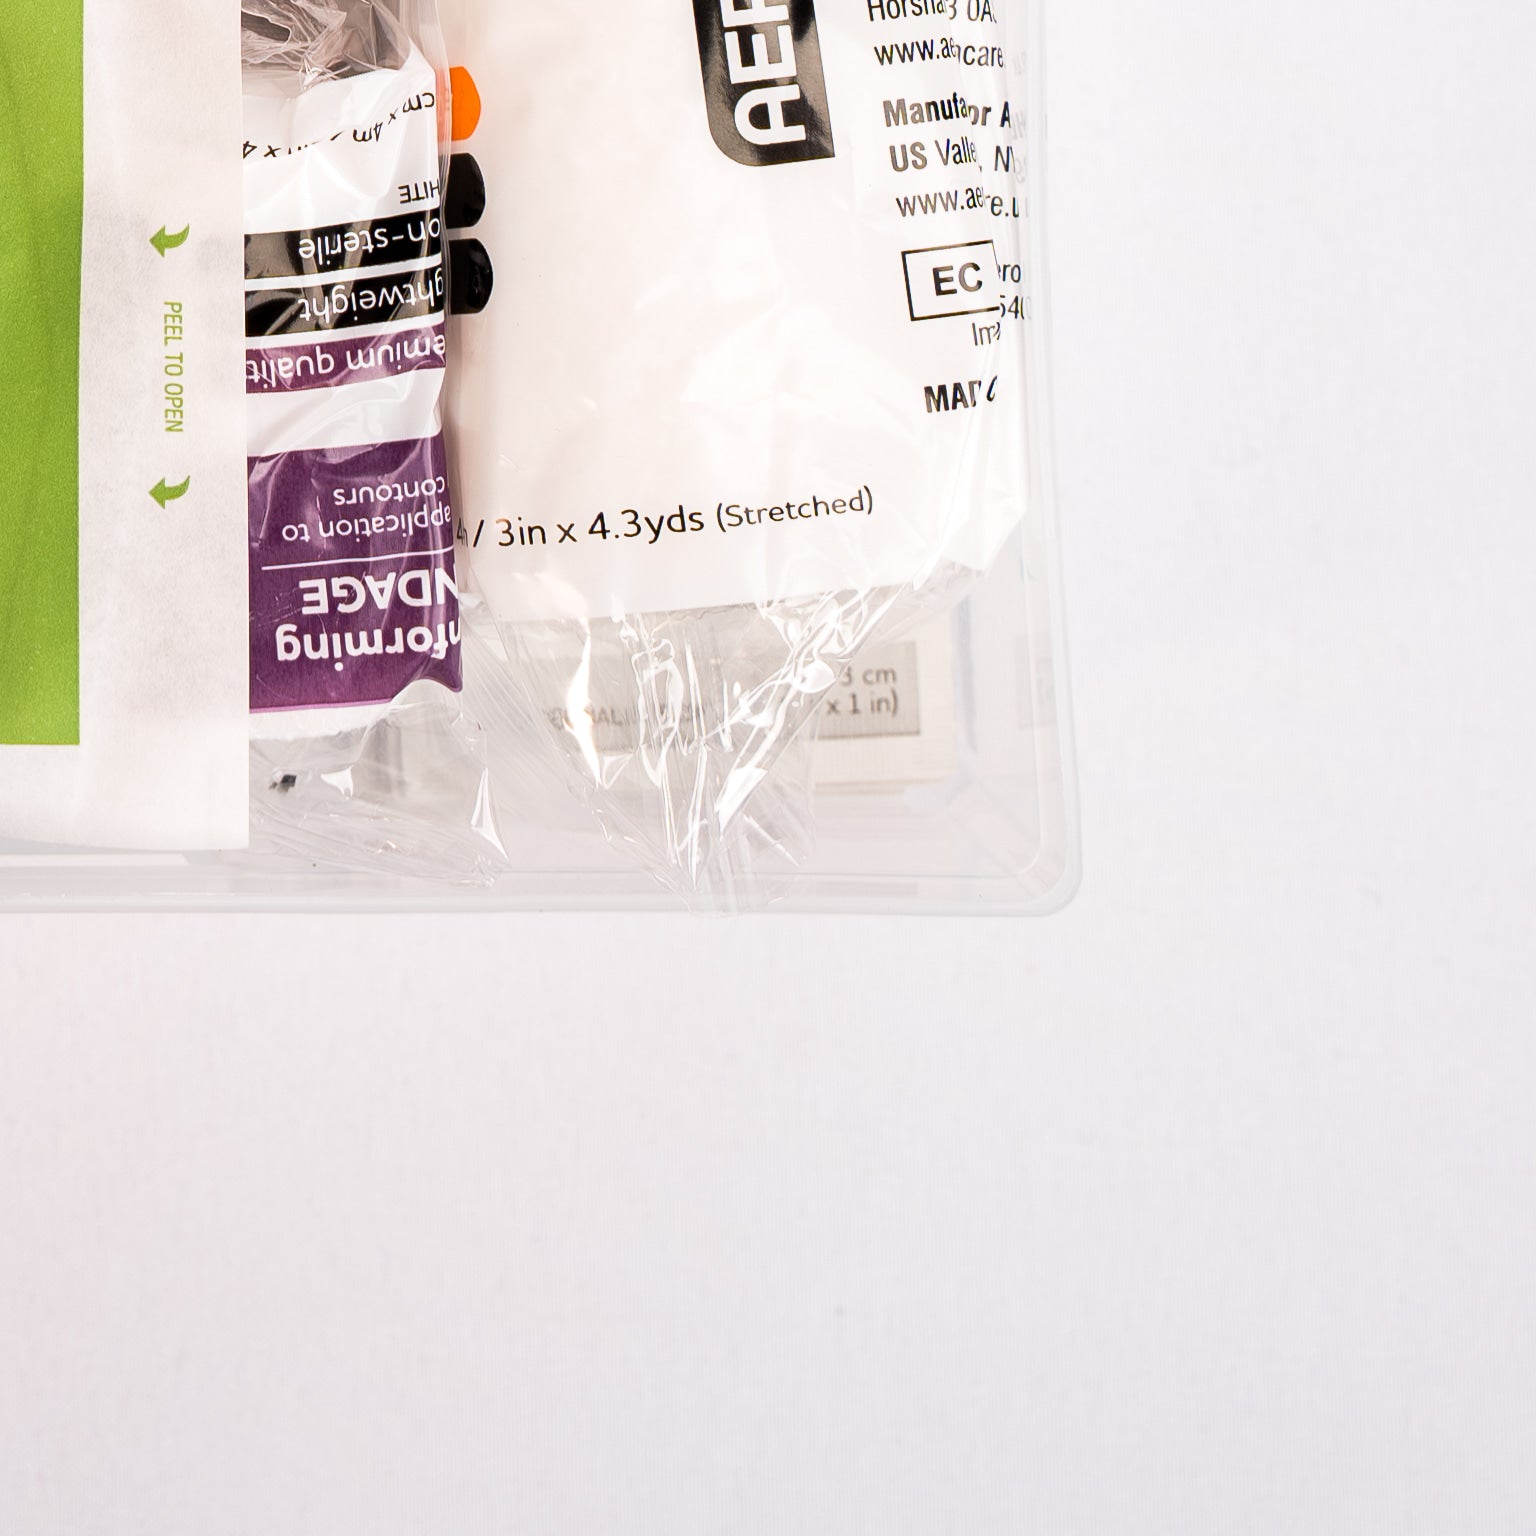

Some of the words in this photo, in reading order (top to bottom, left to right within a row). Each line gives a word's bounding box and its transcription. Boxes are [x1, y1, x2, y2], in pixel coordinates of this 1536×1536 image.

[932, 262, 983, 296] EC
[164, 301, 182, 346] PEEL
[164, 352, 183, 376] TO
[164, 383, 183, 432] OPEN
[333, 476, 445, 505] contours
[497, 517, 549, 547] 3in
[558, 524, 578, 545] x
[587, 507, 705, 547] 4.3yds
[716, 483, 875, 531] (Stretched)
